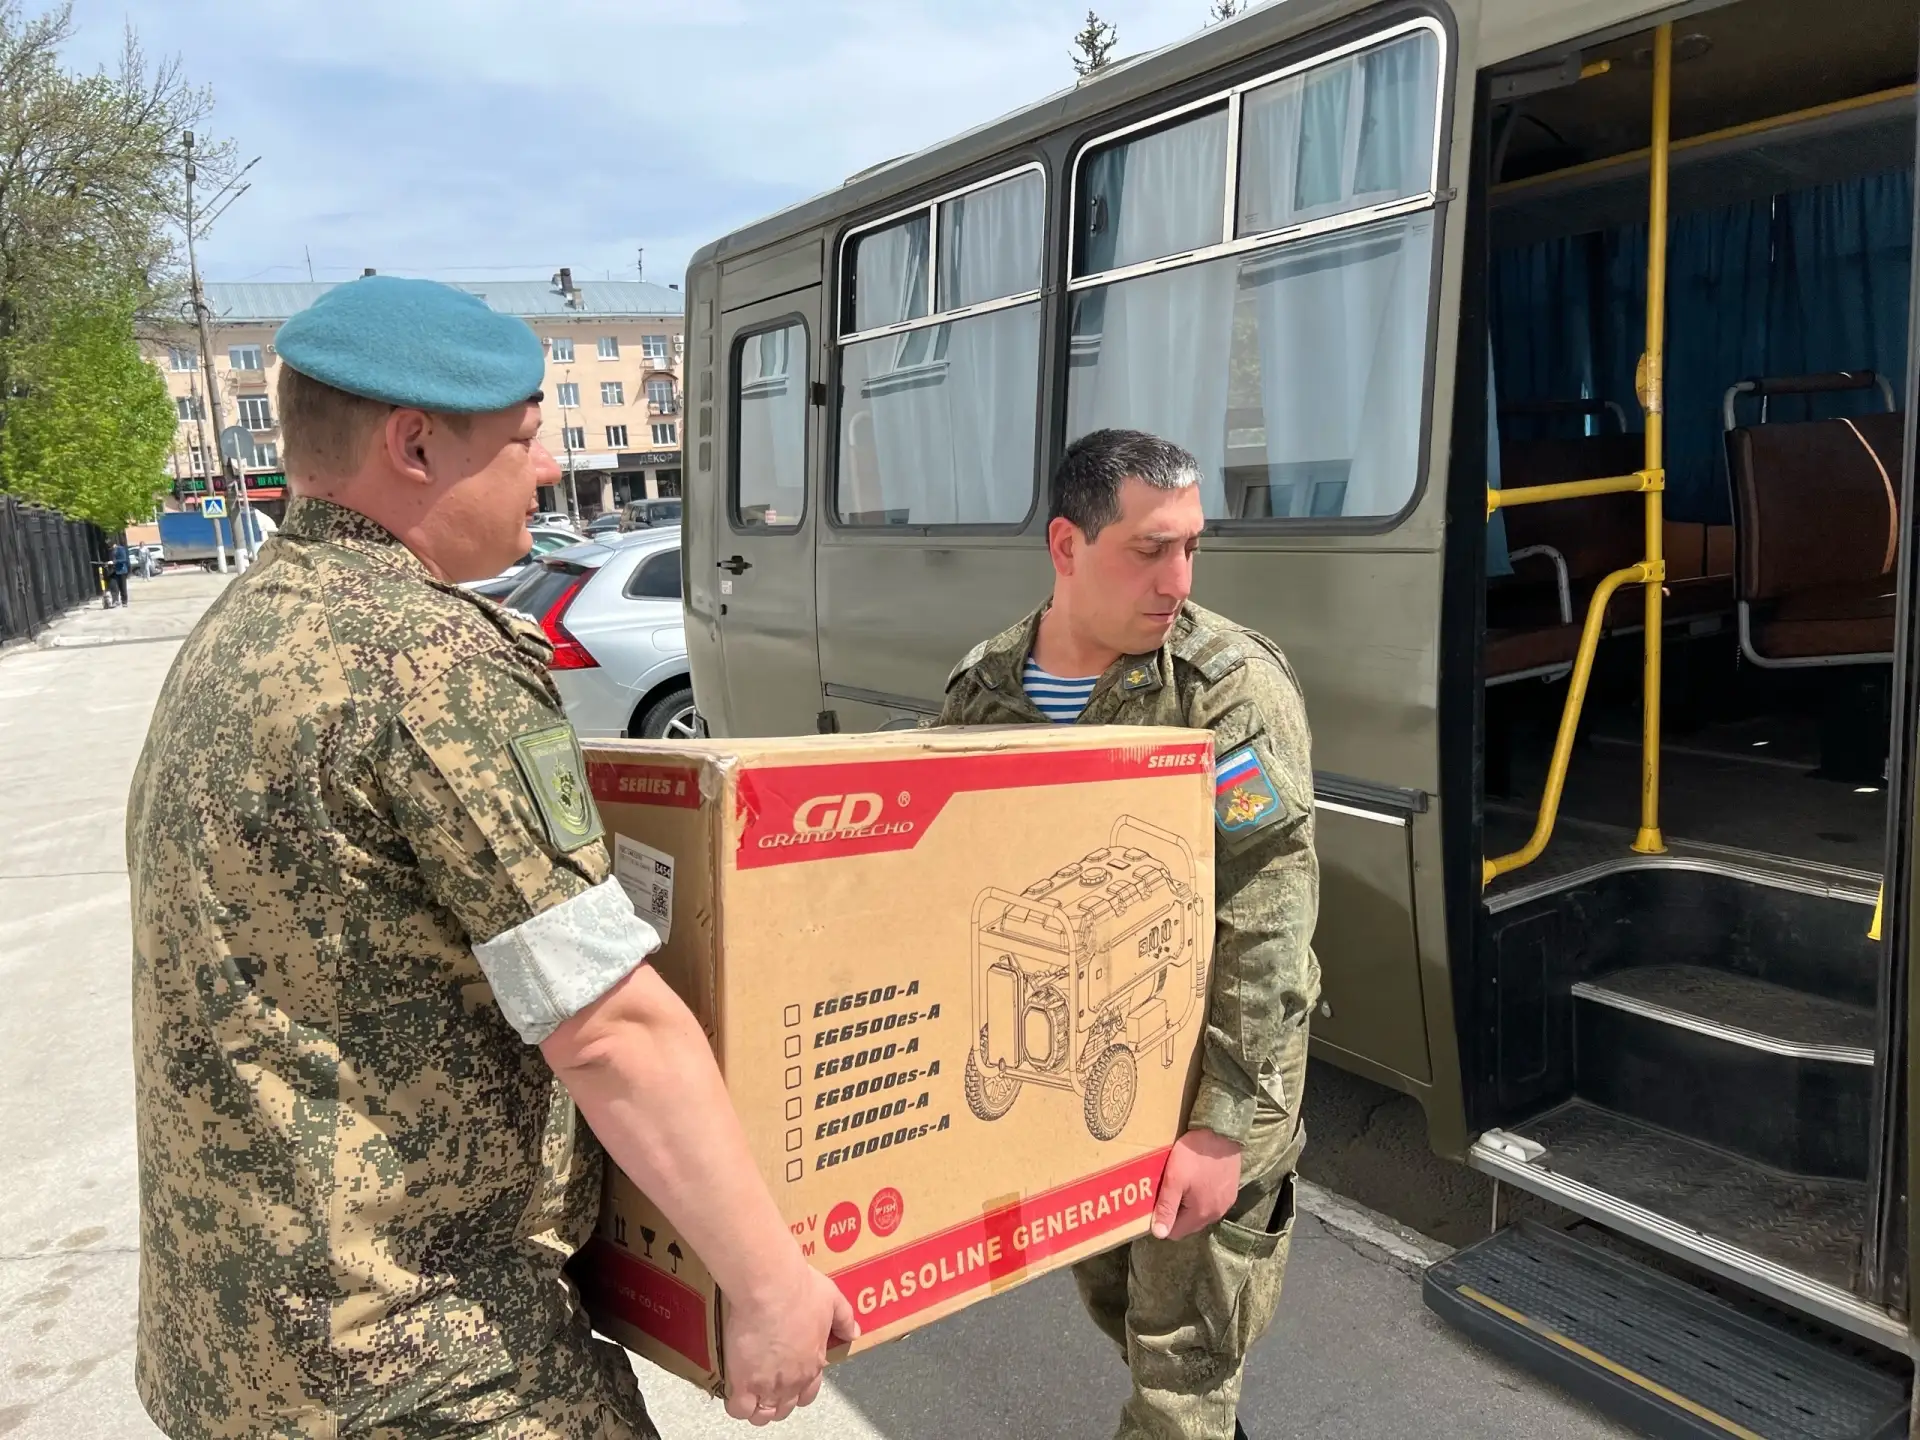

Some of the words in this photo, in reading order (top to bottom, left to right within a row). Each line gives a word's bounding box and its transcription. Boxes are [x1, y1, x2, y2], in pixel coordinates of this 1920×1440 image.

[640, 453, 673, 465] ДЕКОР
[1147, 753, 1197, 768] SERIES
[619, 777, 671, 795] SERIES
[674, 780, 686, 796] A
[792, 792, 884, 834] GD
[758, 830, 836, 849] GRAND
[813, 980, 920, 1019] EG6500-A
[813, 1004, 941, 1049] EG6500es-A
[814, 1037, 919, 1080] EG8000-A
[814, 1060, 941, 1111] EG8000es-A
[814, 1092, 929, 1141] EG10000-A
[815, 1114, 950, 1172] EG10000es-A
[807, 1214, 817, 1231] V
[828, 1217, 857, 1239] AVR
[857, 1236, 1003, 1315] GASOLINE
[1012, 1177, 1152, 1251] GENERATOR
